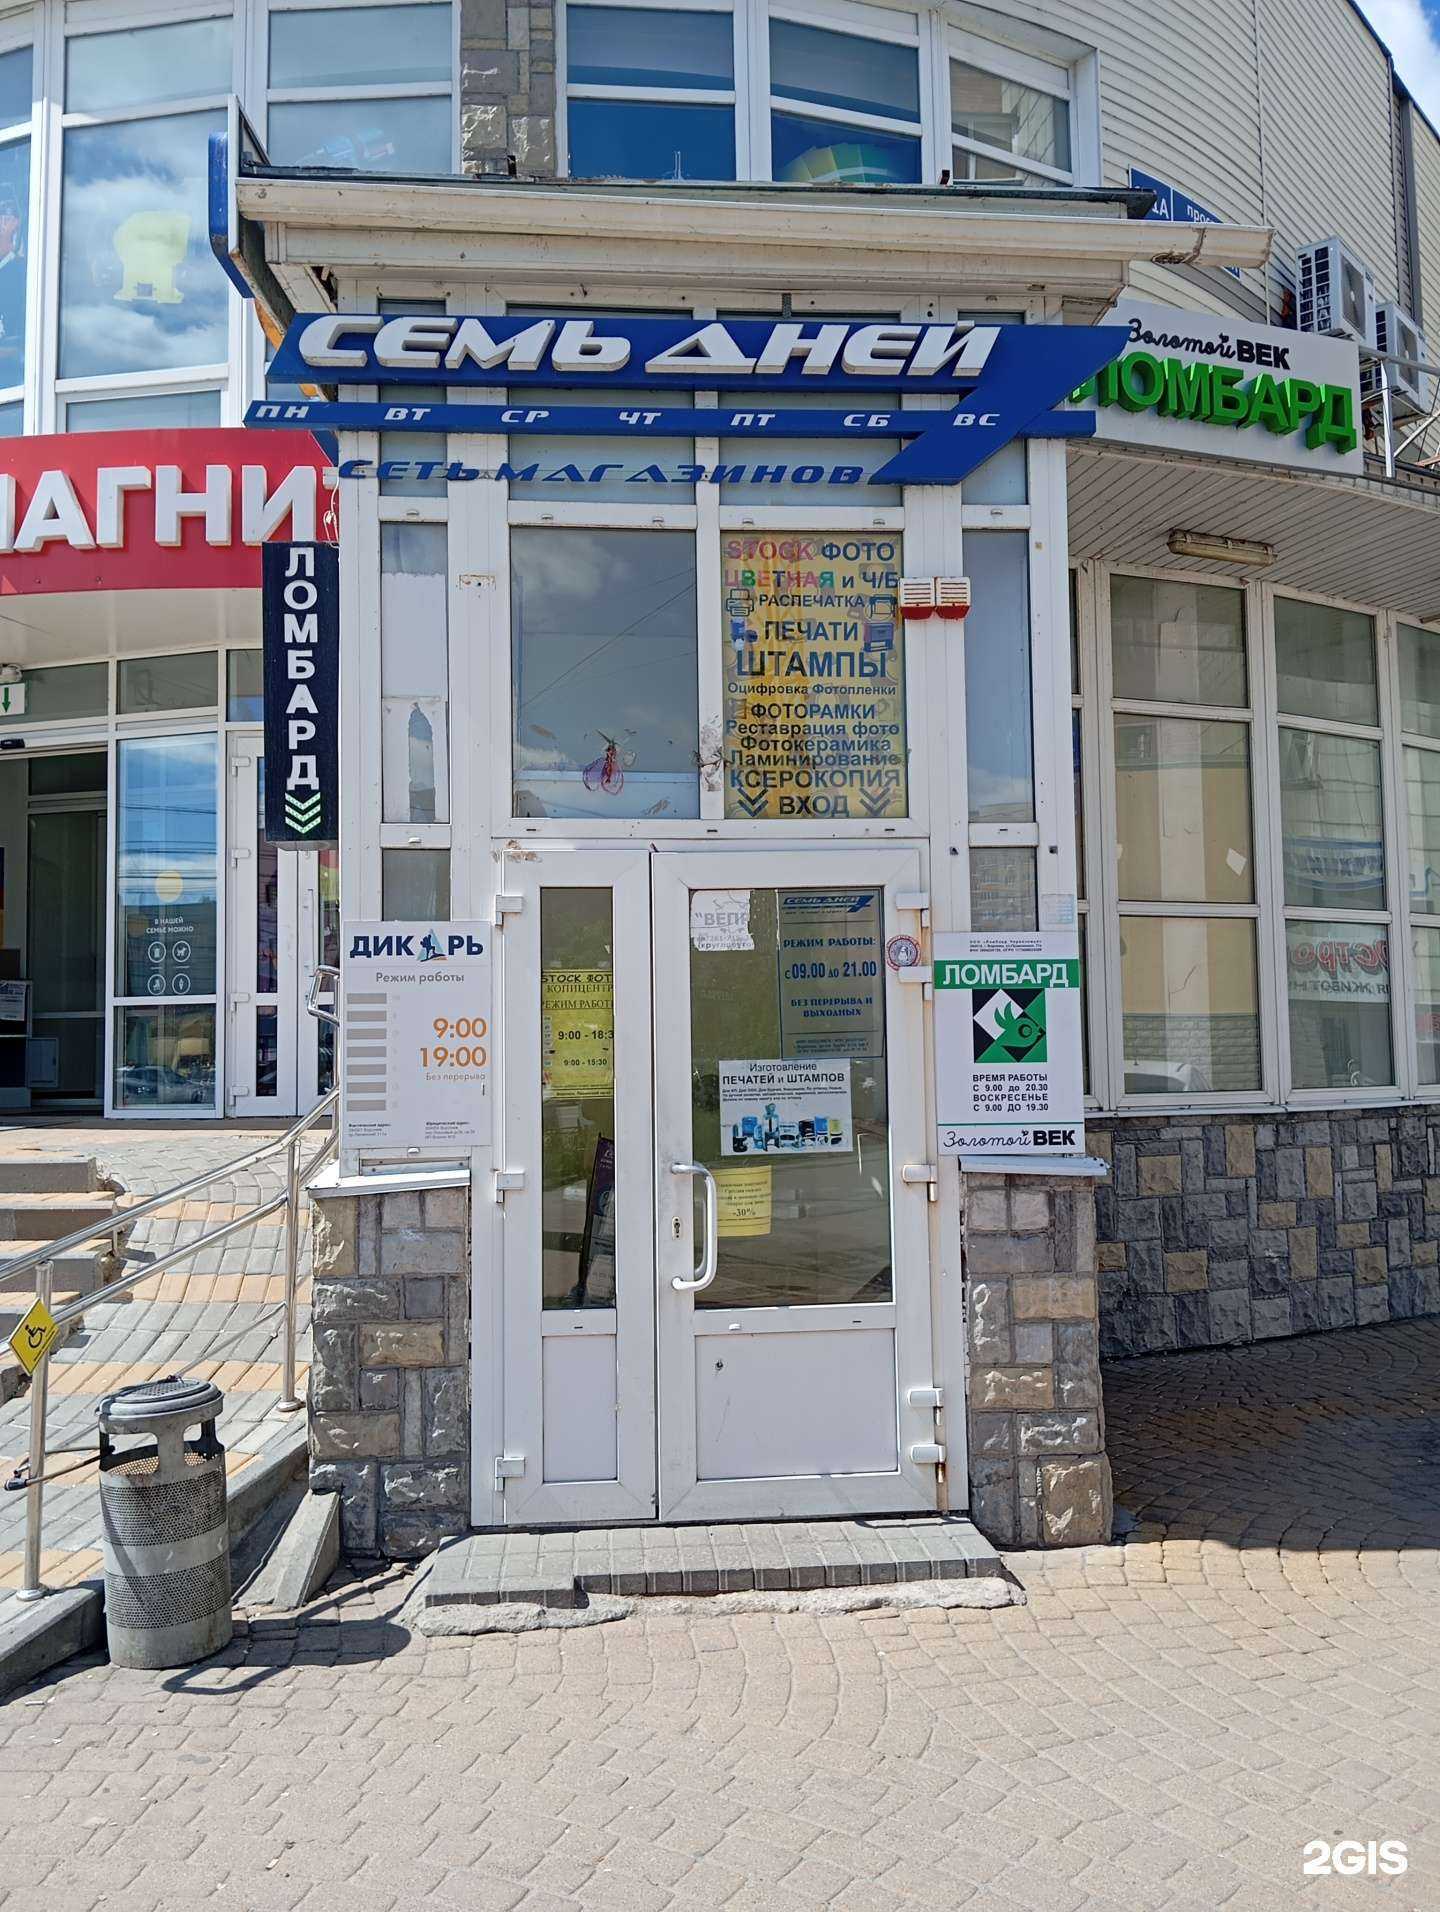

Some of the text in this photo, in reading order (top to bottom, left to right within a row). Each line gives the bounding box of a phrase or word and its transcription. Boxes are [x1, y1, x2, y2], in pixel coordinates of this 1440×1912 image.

[299, 315, 1001, 377] СЕМЬ ДНЕЙ
[1128, 318, 1291, 371] Золотой ВЕК
[255, 405, 1000, 427] ПН ВТ СР ЧТ ПТ СБ ВС
[338, 460, 864, 485] СЕТЬ МАГАЗИНОВ
[0, 464, 338, 554] АГНИ
[727, 540, 896, 562] STOCK ФОТО
[724, 569, 900, 588] ЦВЕТНАЯ и Ч/Б
[759, 593, 866, 608] РАСПЕЧАТКА
[764, 621, 859, 641] ПЕЧАТИ
[283, 547, 320, 791] ЛОМБАРД
[736, 651, 887, 678] ШТАМПЫ
[727, 682, 897, 696] Оцифровка Фотопленки
[751, 703, 876, 720] ФОТОРАМКИ
[725, 720, 900, 738] Реставрация фото
[740, 735, 892, 752] Фотокерамика
[729, 750, 899, 769] Ламинирование
[730, 769, 900, 789] КСЕРОКОПИЯ
[779, 795, 850, 818] ВХОД
[784, 938, 824, 948] РЕЖИМ
[376, 971, 465, 985] Режим работы
[542, 974, 582, 983] STOCK
[791, 962, 826, 979] 09.00
[843, 961, 877, 977] 21.00
[942, 963, 1070, 988] ЛОМБАРД
[542, 999, 613, 1009] ЕЖИМ РАБОТ
[791, 998, 808, 1007] БЕЗ
[803, 1008, 862, 1017] ВЫХОДНЫХ
[433, 1017, 488, 1039] 9:00
[558, 1030, 581, 1040] 9:00
[420, 1046, 488, 1068] 19:00
[750, 1063, 818, 1072] Изготовление
[722, 1073, 775, 1085] ПЕЧАТЕЙ
[787, 1072, 845, 1083] ШТАМПОВ
[972, 1073, 1048, 1082] ВРЕМЯ РАБОТЫ
[985, 1084, 1003, 1092] 9.00
[1008, 1085, 1020, 1093] до
[1025, 1083, 1048, 1092] 20.30
[973, 1093, 1049, 1102] ВОСКРЕСЕНЬЕ
[985, 1104, 1003, 1112] 9.00
[1007, 1104, 1021, 1113] ДО
[1026, 1103, 1049, 1112] 19.30
[943, 1130, 1076, 1148] Золотой ВЕК
